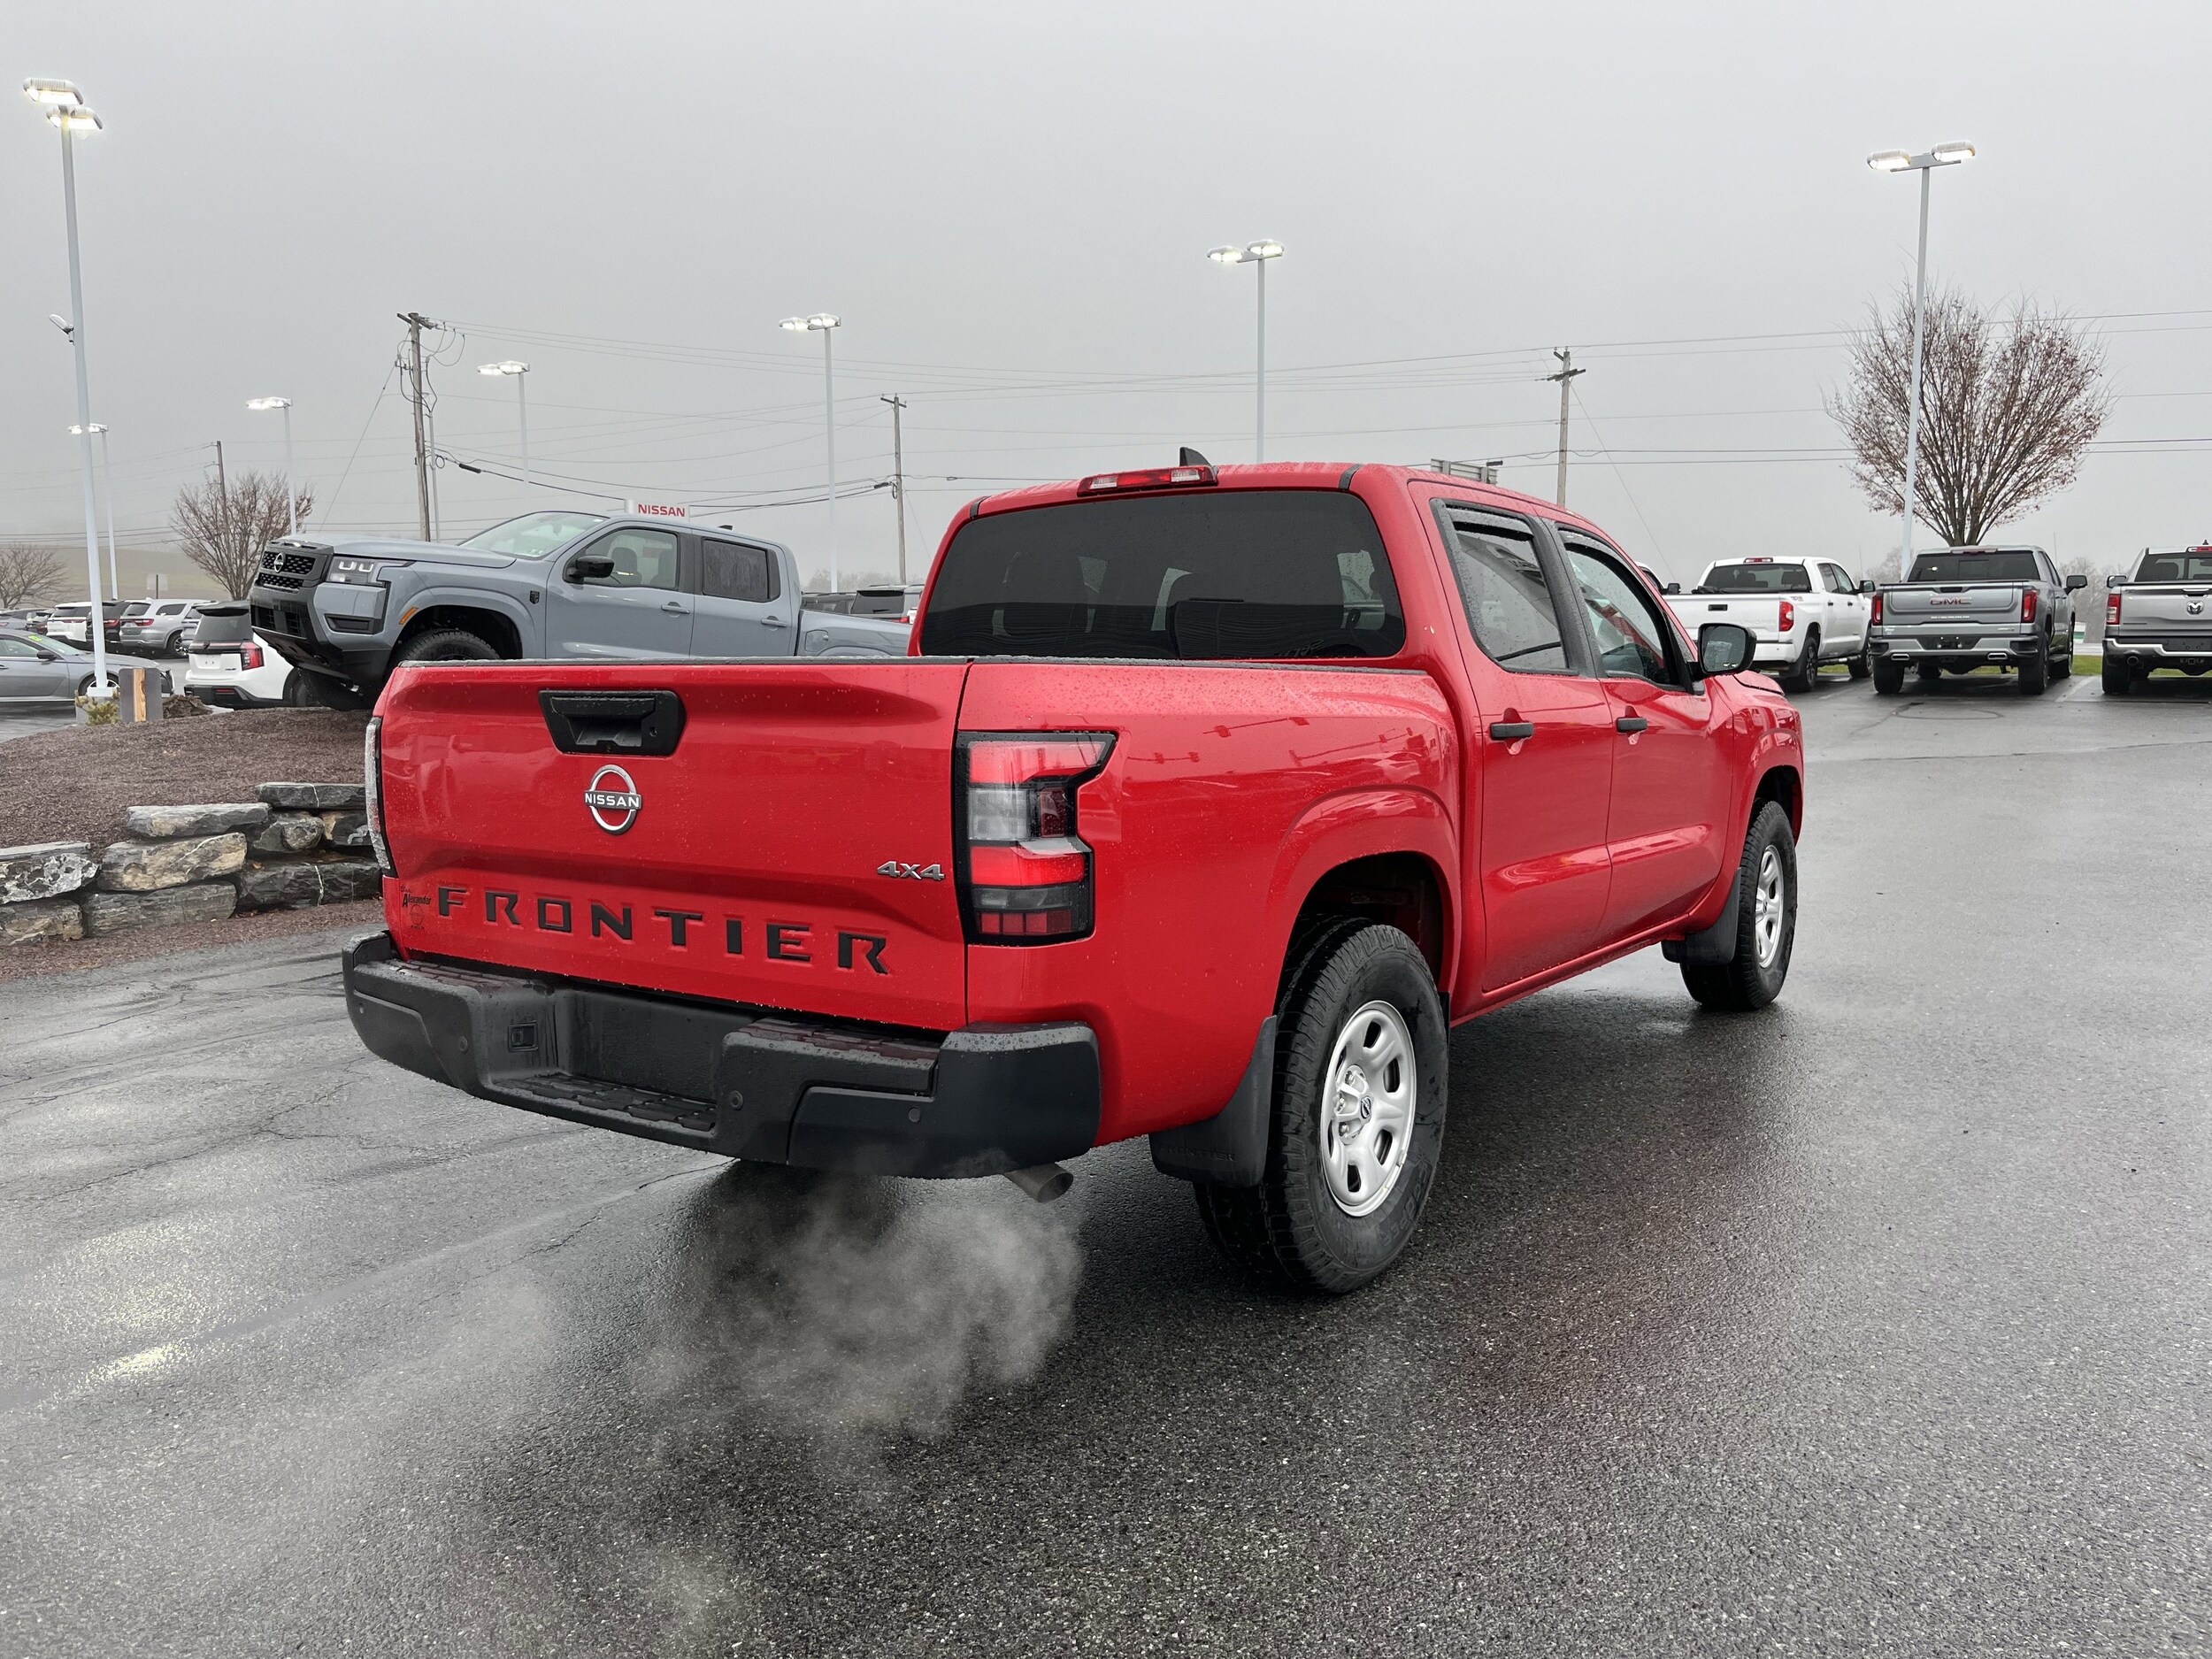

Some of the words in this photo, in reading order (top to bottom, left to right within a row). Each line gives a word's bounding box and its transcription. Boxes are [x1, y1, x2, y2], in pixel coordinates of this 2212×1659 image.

[637, 503, 686, 518] NISSAN
[1930, 596, 1972, 606] GMC
[585, 793, 640, 808] NISSAN
[438, 886, 889, 975] FRONTIER
